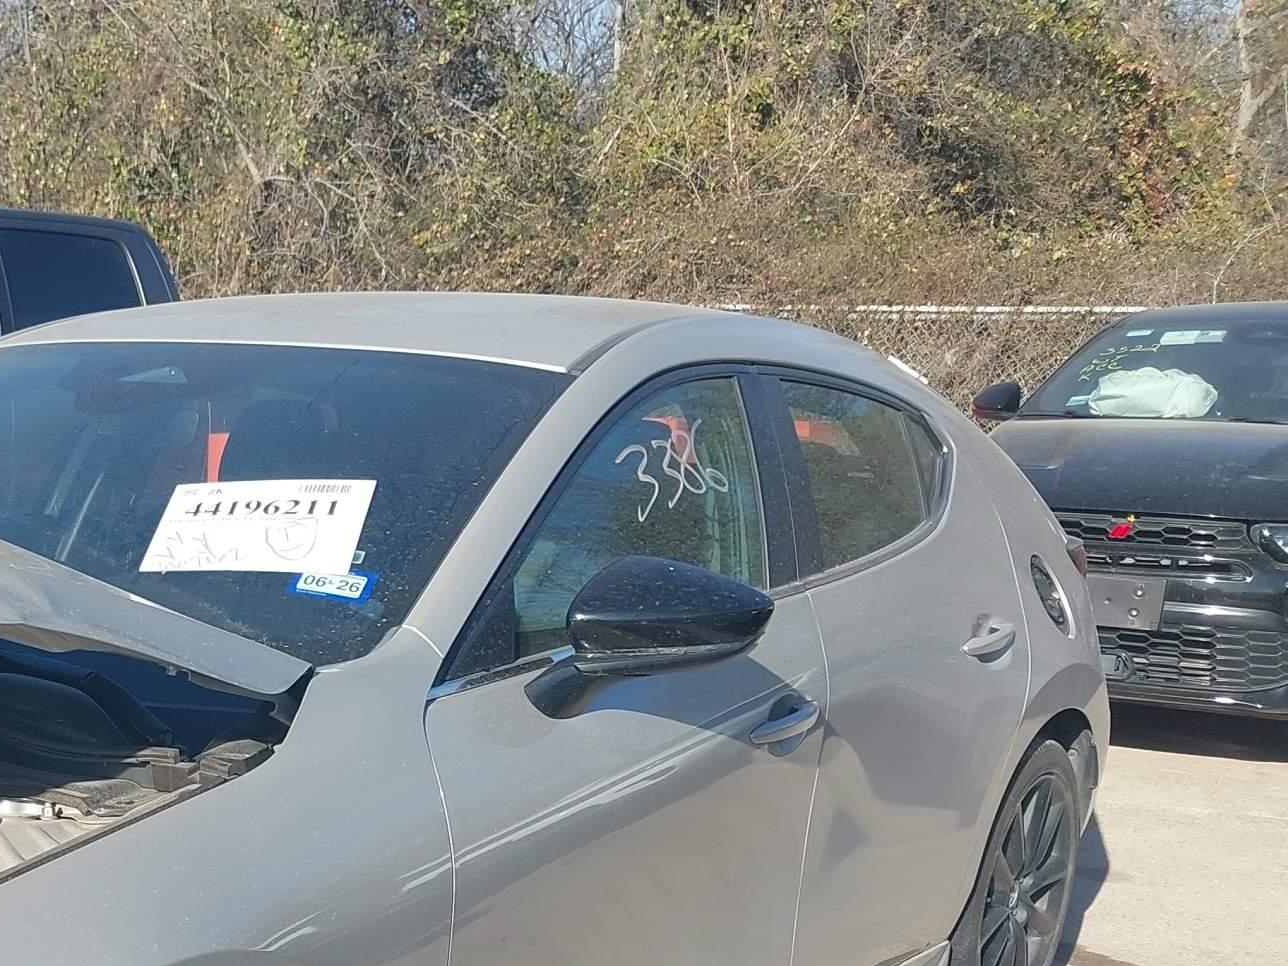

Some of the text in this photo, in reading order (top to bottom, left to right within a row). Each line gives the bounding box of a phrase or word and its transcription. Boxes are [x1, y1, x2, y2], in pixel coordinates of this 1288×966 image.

[185, 499, 338, 517] 44196211
[303, 574, 362, 593] 06 26
